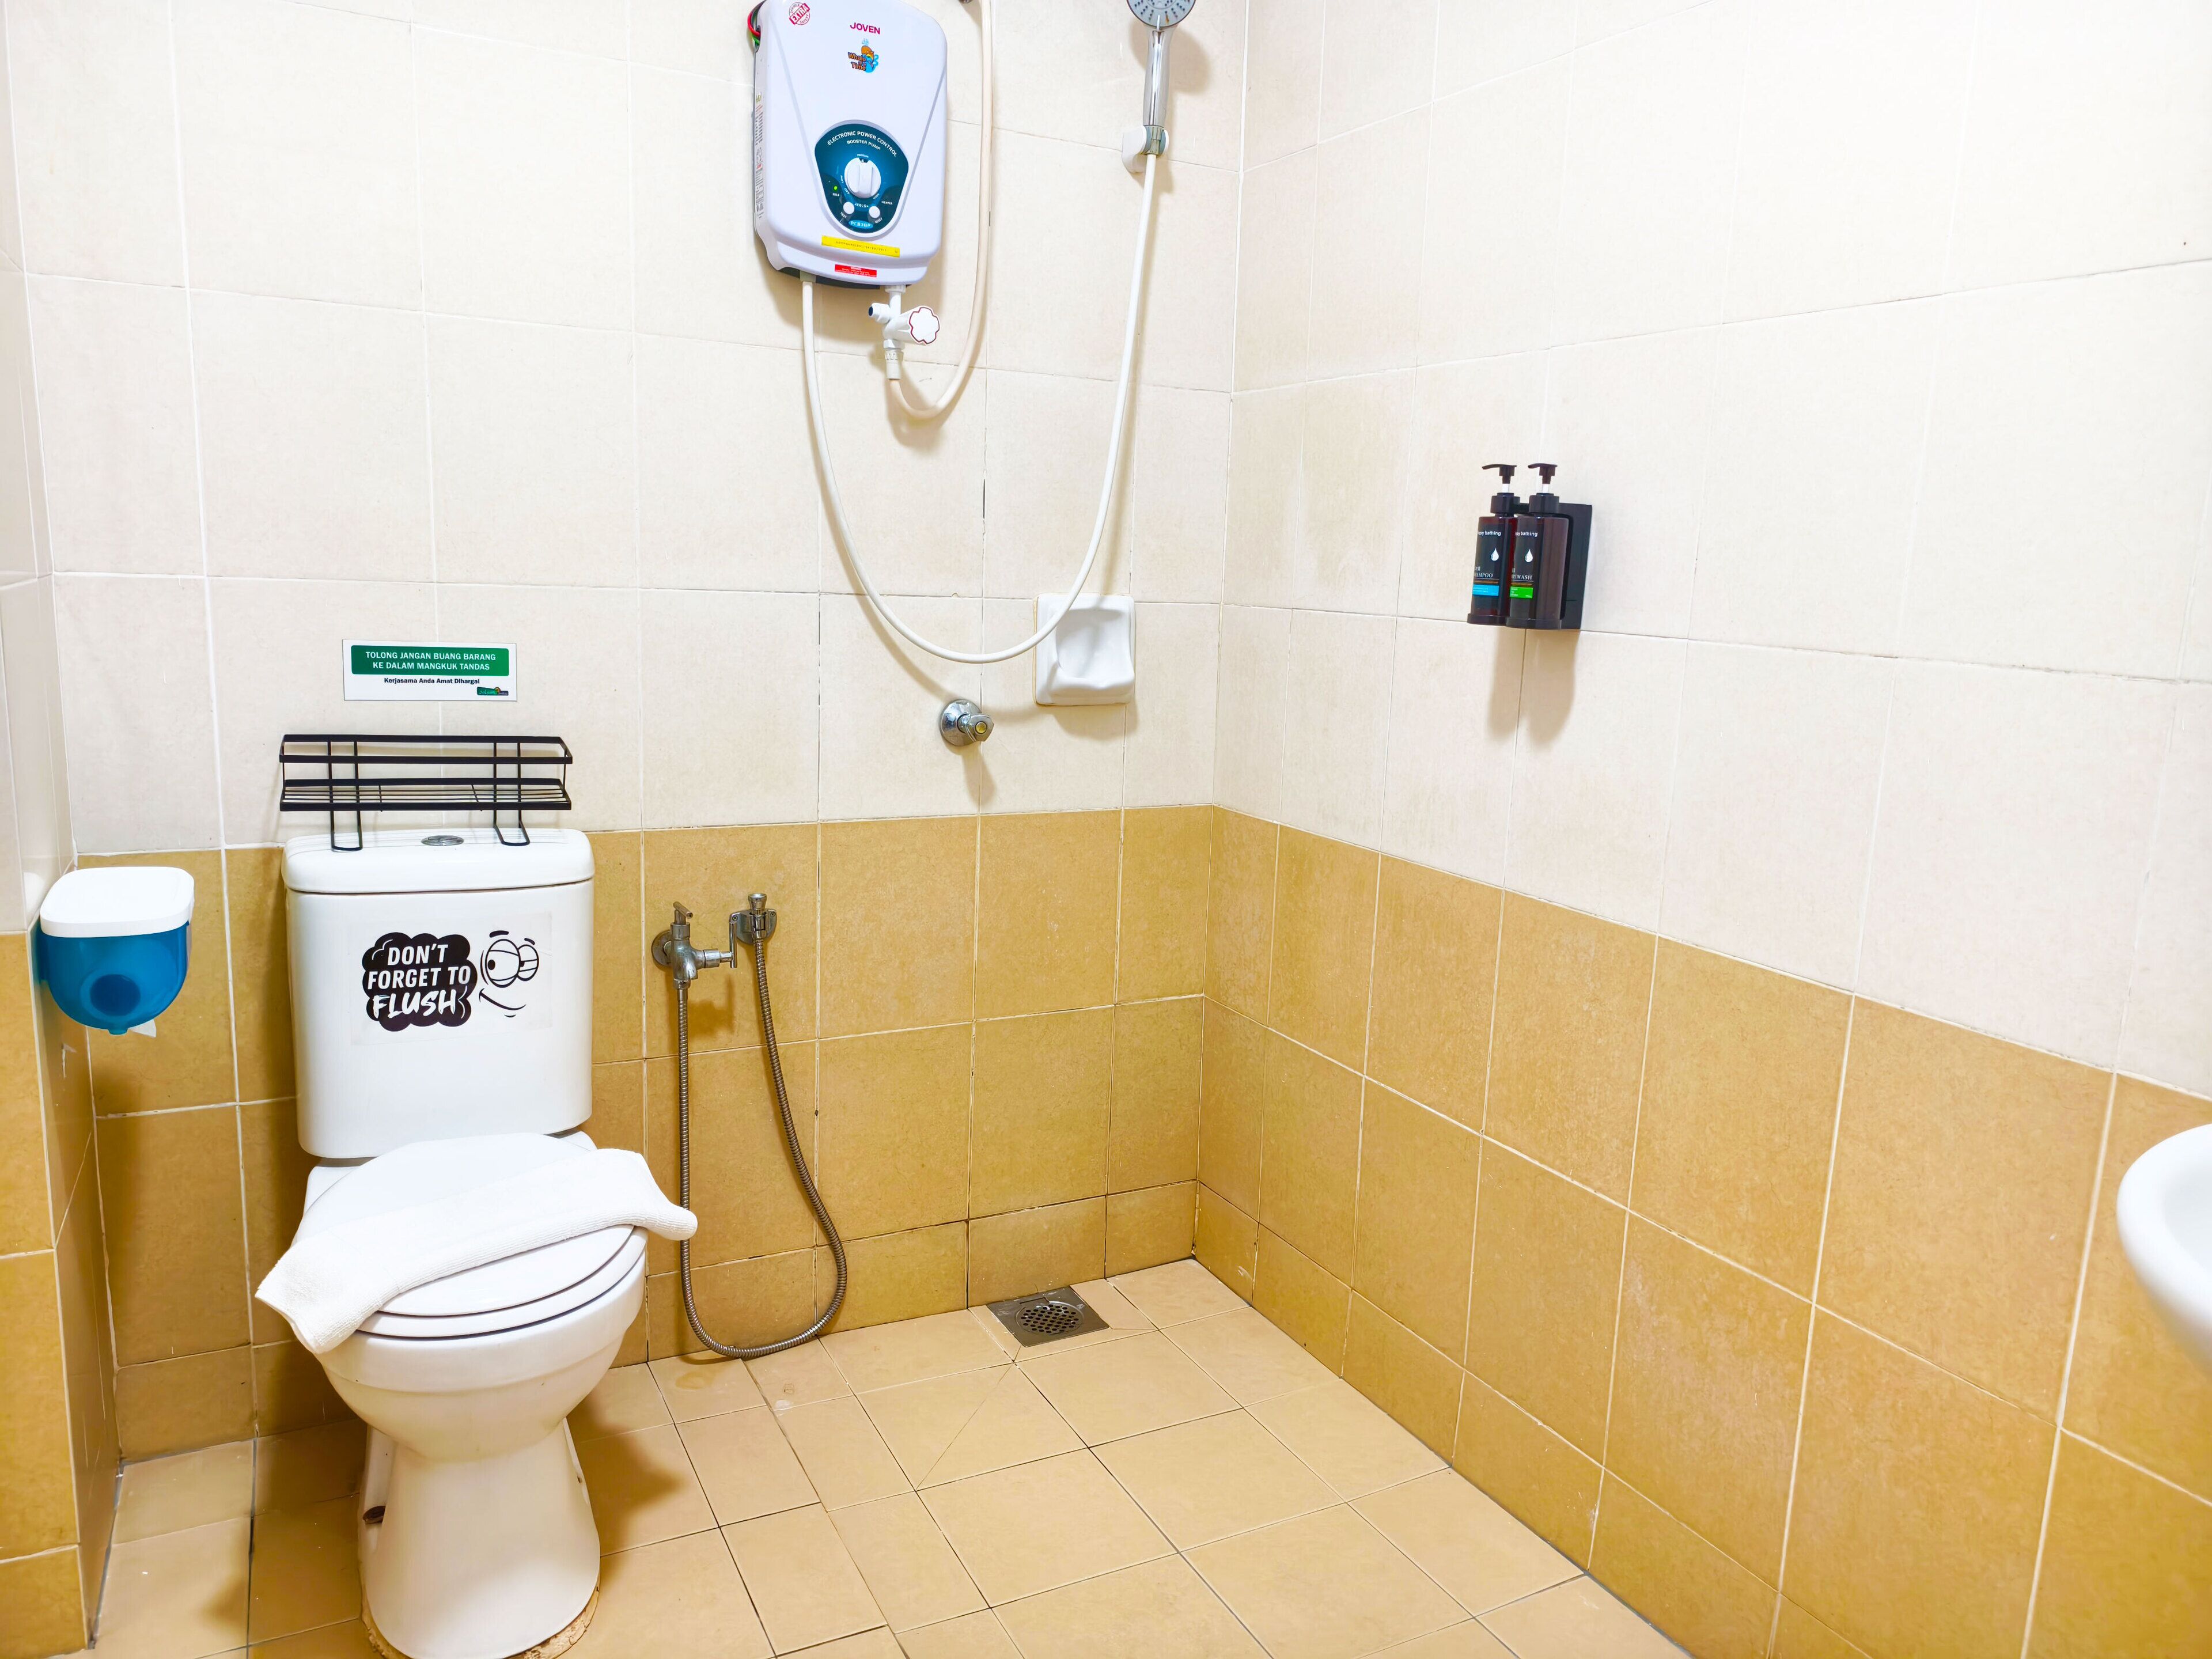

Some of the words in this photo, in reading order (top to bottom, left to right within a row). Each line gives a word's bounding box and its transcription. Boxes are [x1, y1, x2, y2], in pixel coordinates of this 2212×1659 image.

[790, 4, 809, 24] EXTRA
[850, 22, 880, 35] JOVEN
[827, 131, 856, 145] ELECTRONIC
[857, 131, 876, 140] POWER
[877, 138, 897, 157] CONTROL
[868, 142, 881, 150] PUMP
[387, 944, 448, 965] DON'T
[368, 968, 441, 990] FORGET
[448, 965, 471, 984] TO
[373, 989, 457, 1019] FLUSH
